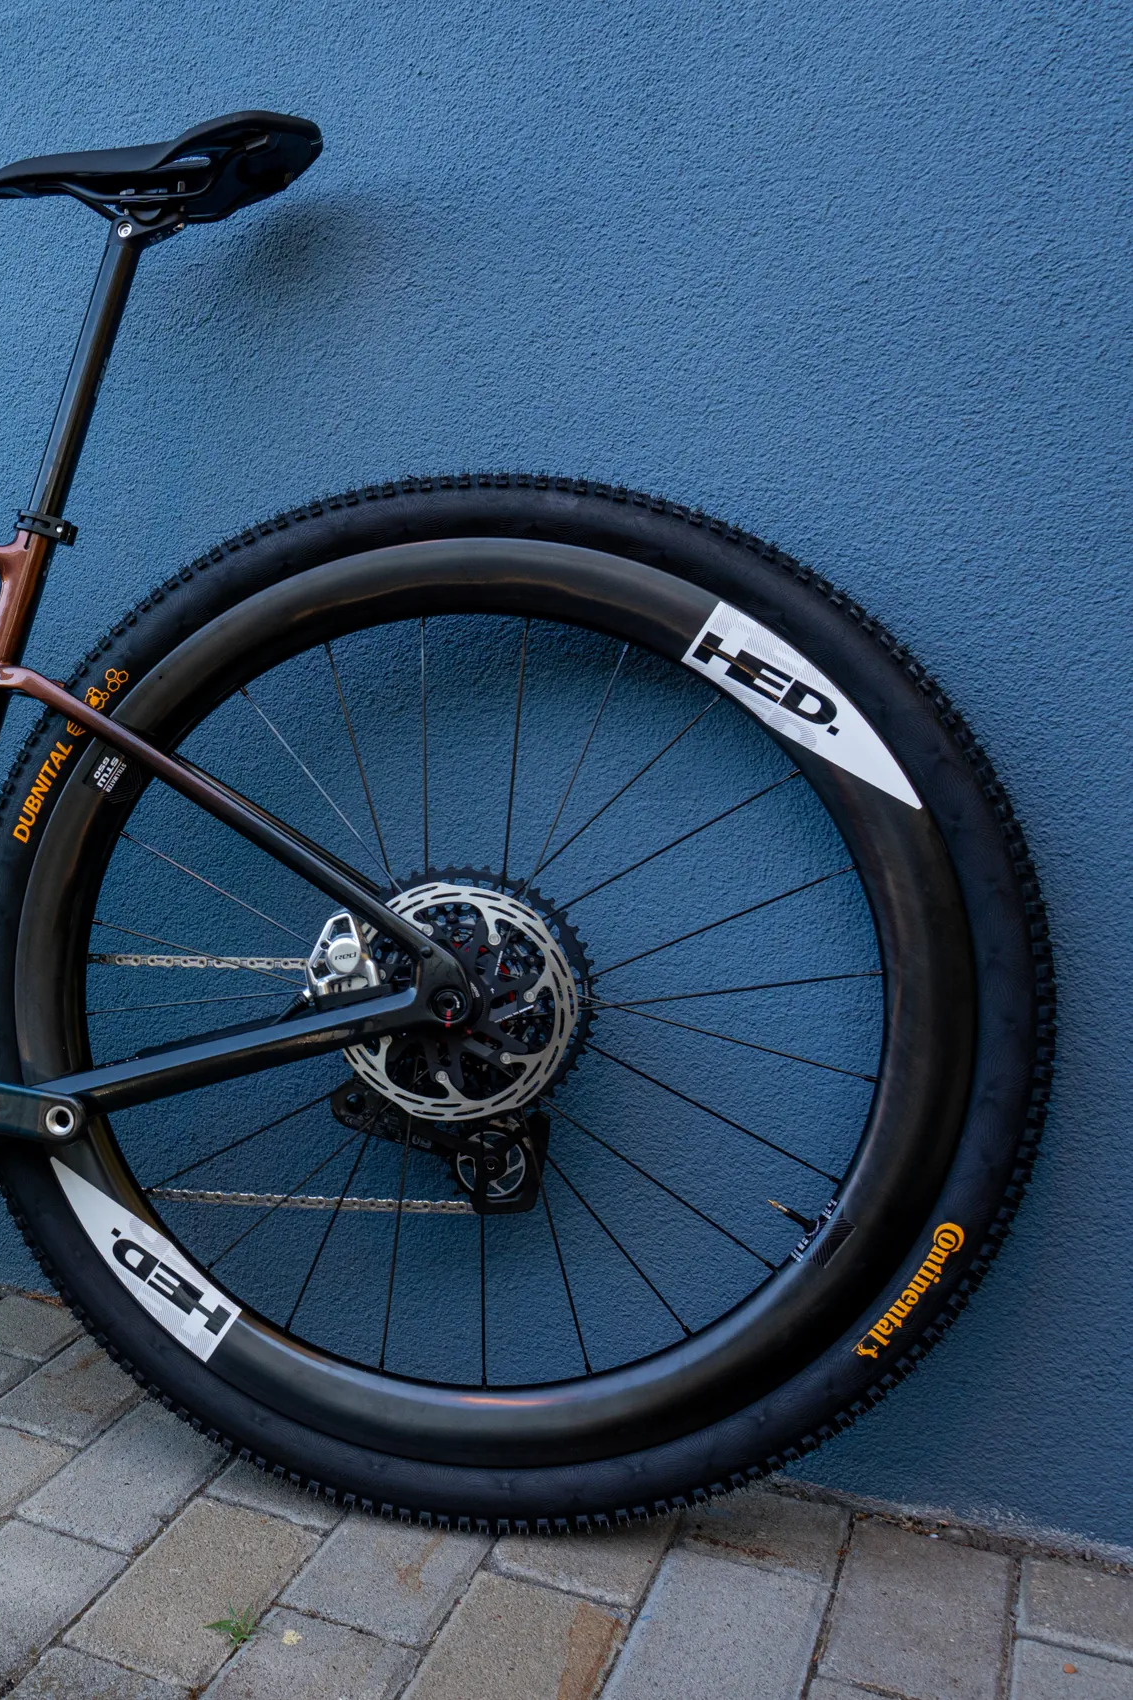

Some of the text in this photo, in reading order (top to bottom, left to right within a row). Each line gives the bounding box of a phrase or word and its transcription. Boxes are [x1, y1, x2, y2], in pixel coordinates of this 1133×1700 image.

[692, 631, 840, 736] HED.
[13, 741, 73, 844] DUBNITAL
[106, 763, 127, 793] STILLWATER
[111, 1227, 232, 1336] HED.
[867, 1222, 965, 1347] Continental
